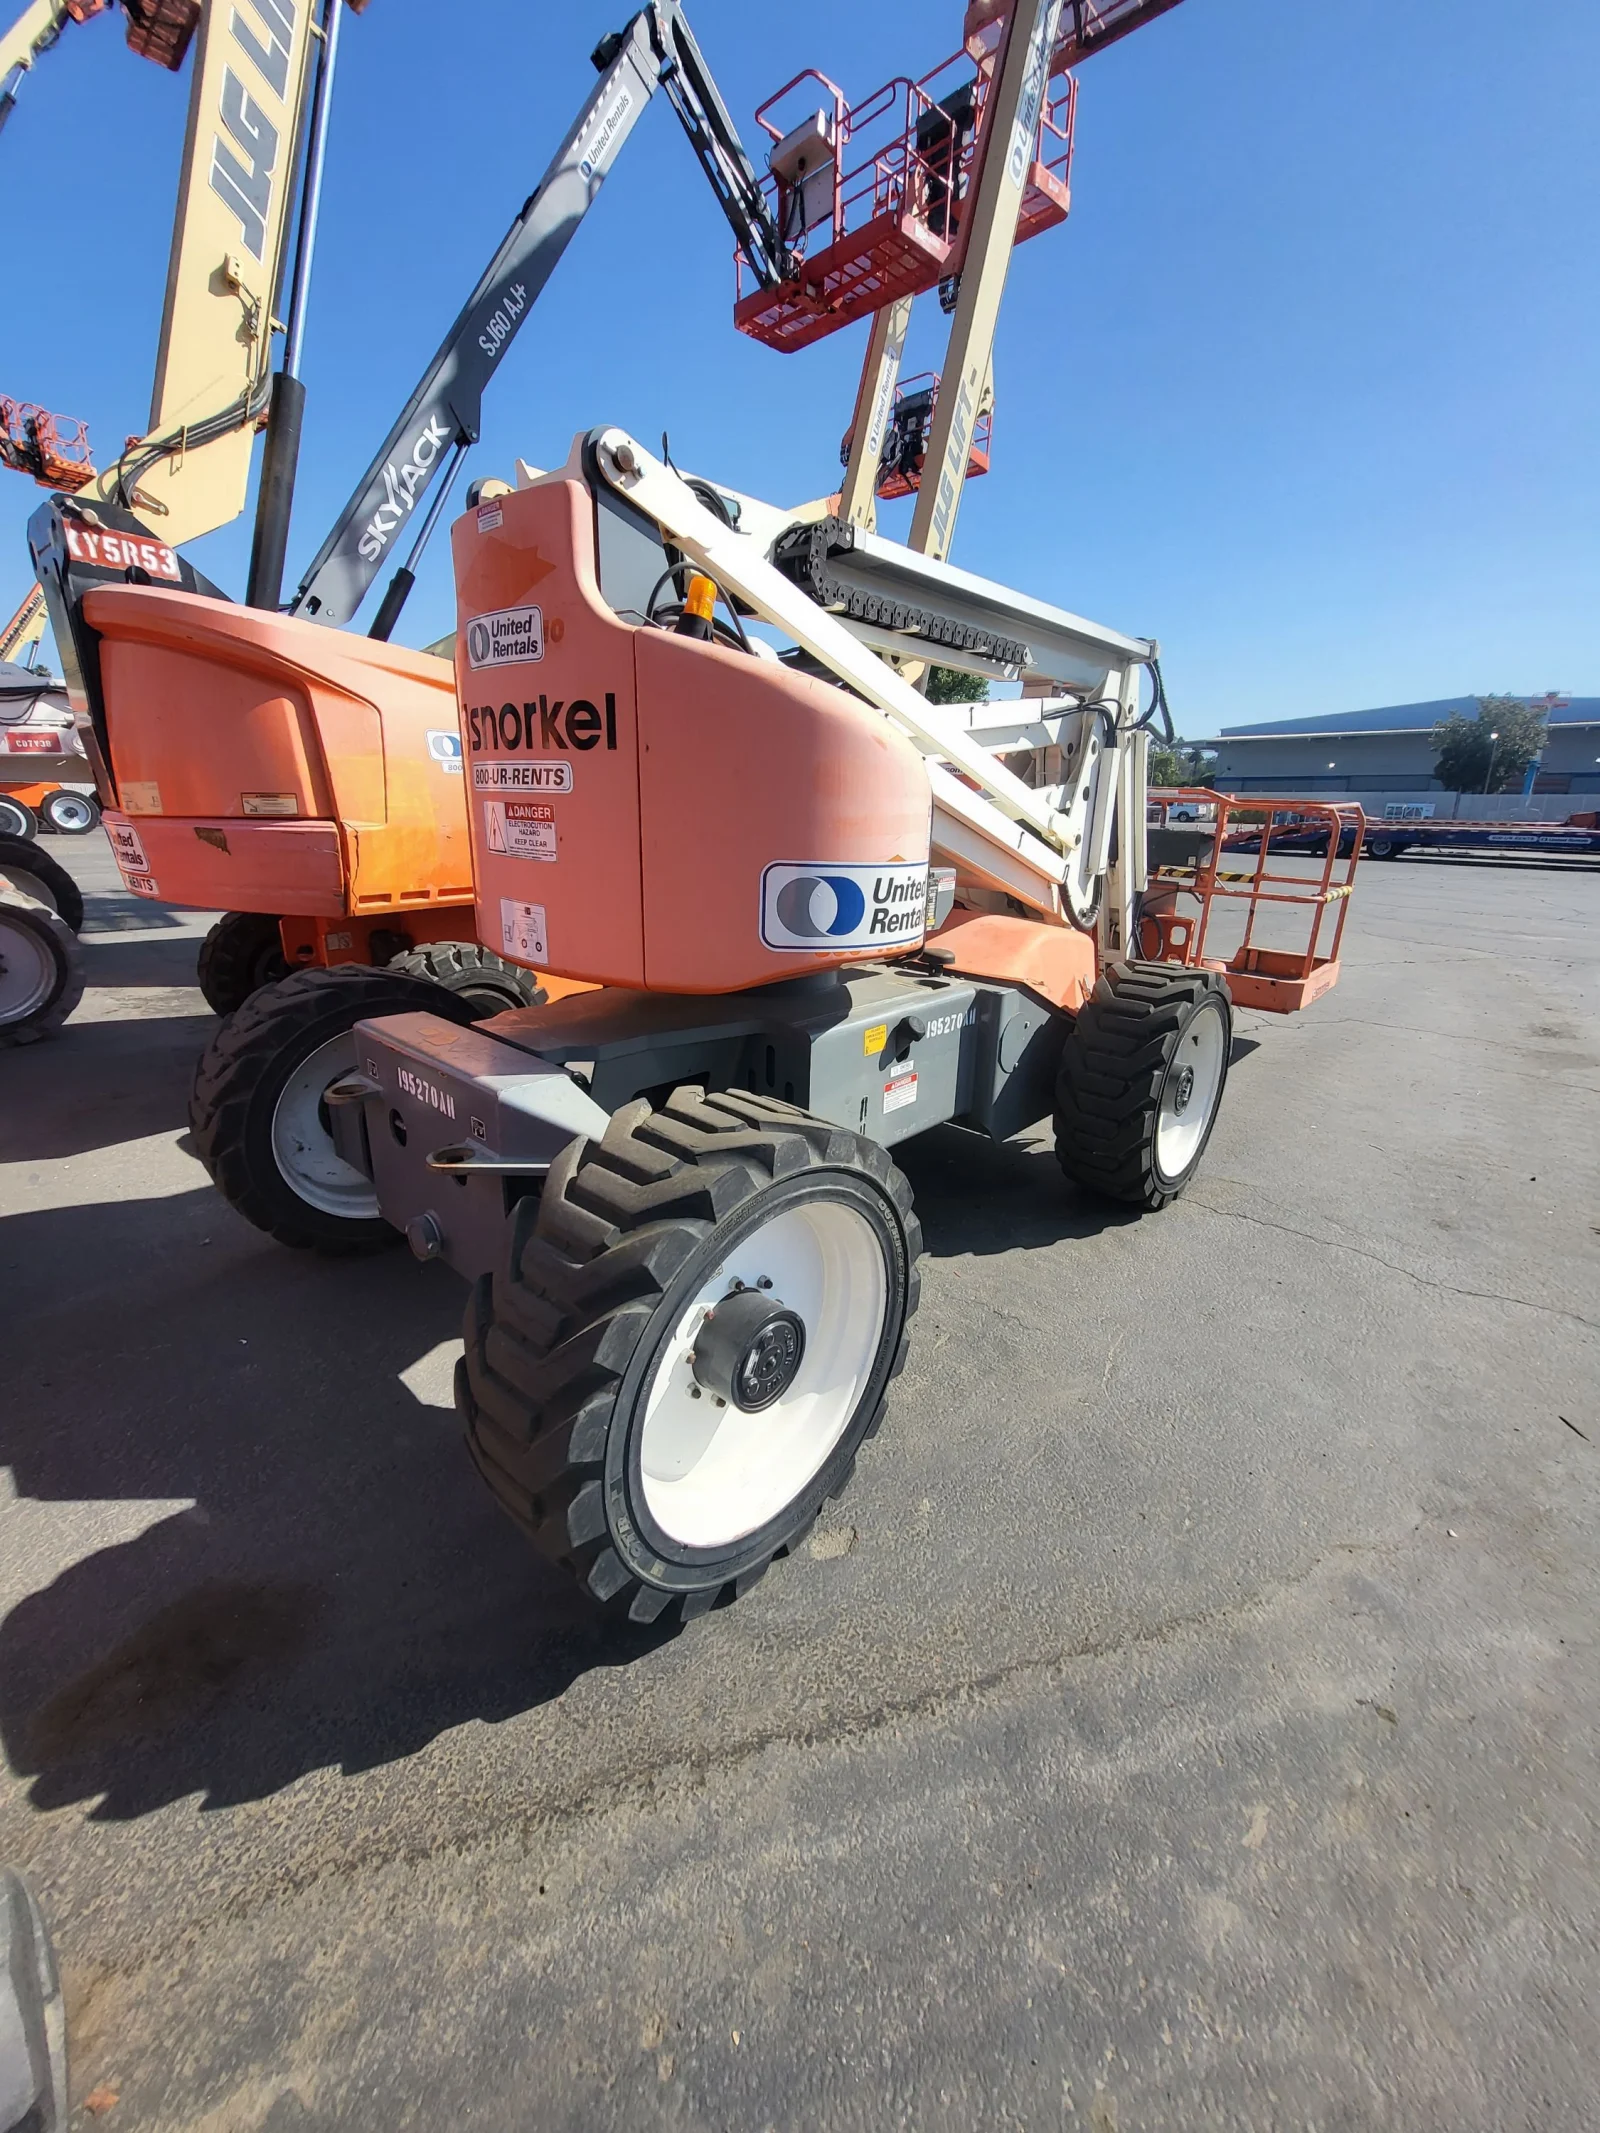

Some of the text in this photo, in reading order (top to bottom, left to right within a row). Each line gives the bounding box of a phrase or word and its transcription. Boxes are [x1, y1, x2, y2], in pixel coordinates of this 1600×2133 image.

[587, 94, 631, 165] United Rentals
[208, 61, 281, 267] JLG
[478, 311, 512, 357] SJ60
[873, 353, 896, 436] United Rentals
[933, 377, 973, 551] JLG LIFT
[358, 413, 451, 562] SKYJACK
[491, 614, 533, 639] United
[492, 636, 538, 658] Rentals
[470, 692, 617, 750] snorkel
[475, 767, 565, 786] 800-UR-RENTS
[508, 820, 553, 830] ELECTROCUTION
[513, 805, 551, 819] DANGER
[514, 838, 548, 848] KEEP CLEAR
[519, 828, 541, 836] HAZARD
[873, 873, 927, 904] United
